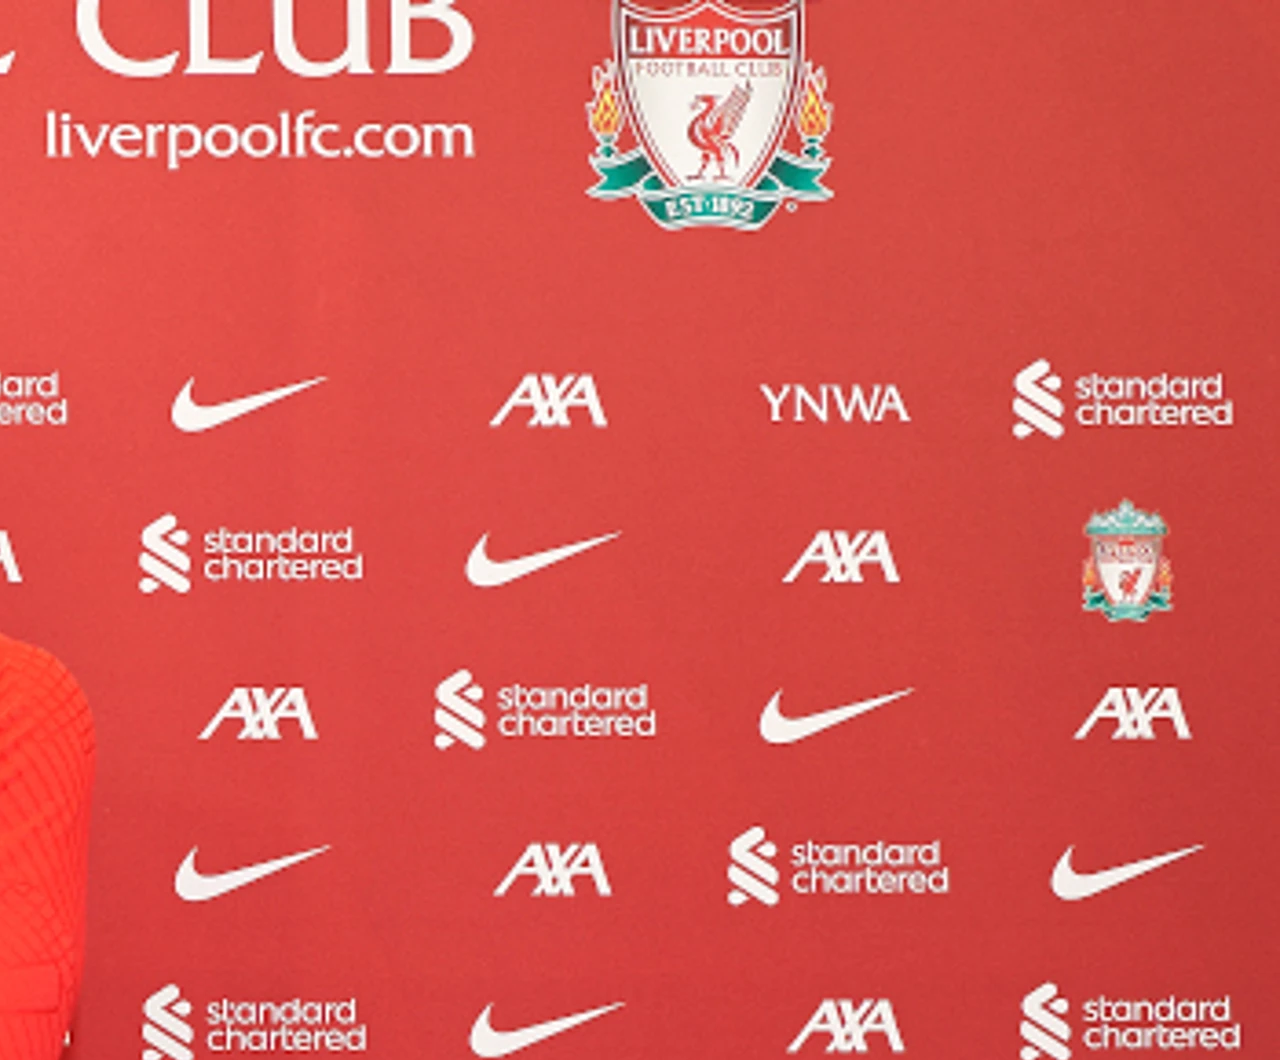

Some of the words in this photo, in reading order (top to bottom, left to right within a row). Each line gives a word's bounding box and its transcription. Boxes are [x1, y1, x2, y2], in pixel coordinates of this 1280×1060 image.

[74, 0, 475, 78] CLUB
[629, 28, 789, 55] LIVERPOOL
[635, 62, 729, 76] FOOTBALL
[734, 62, 783, 76] CLUB
[46, 109, 475, 170] liverpoolfc.com
[1075, 373, 1222, 399] standard
[489, 373, 608, 428] AXA
[760, 384, 911, 423] YNWA
[1075, 399, 1233, 425] chartered
[204, 527, 353, 553] standard
[204, 553, 363, 581] chartered
[782, 530, 900, 583] AXA
[497, 684, 647, 710] standard
[198, 687, 318, 740] AXA
[497, 710, 656, 736] chartered
[1074, 688, 1192, 740] AXA
[791, 840, 940, 867] standard
[494, 843, 611, 896] AXA
[791, 867, 949, 893] chartered
[207, 998, 356, 1025] standard
[1083, 995, 1230, 1022] standard
[207, 1025, 366, 1050] chartered
[787, 999, 904, 1053] AXA
[1083, 1024, 1240, 1049] chartered
